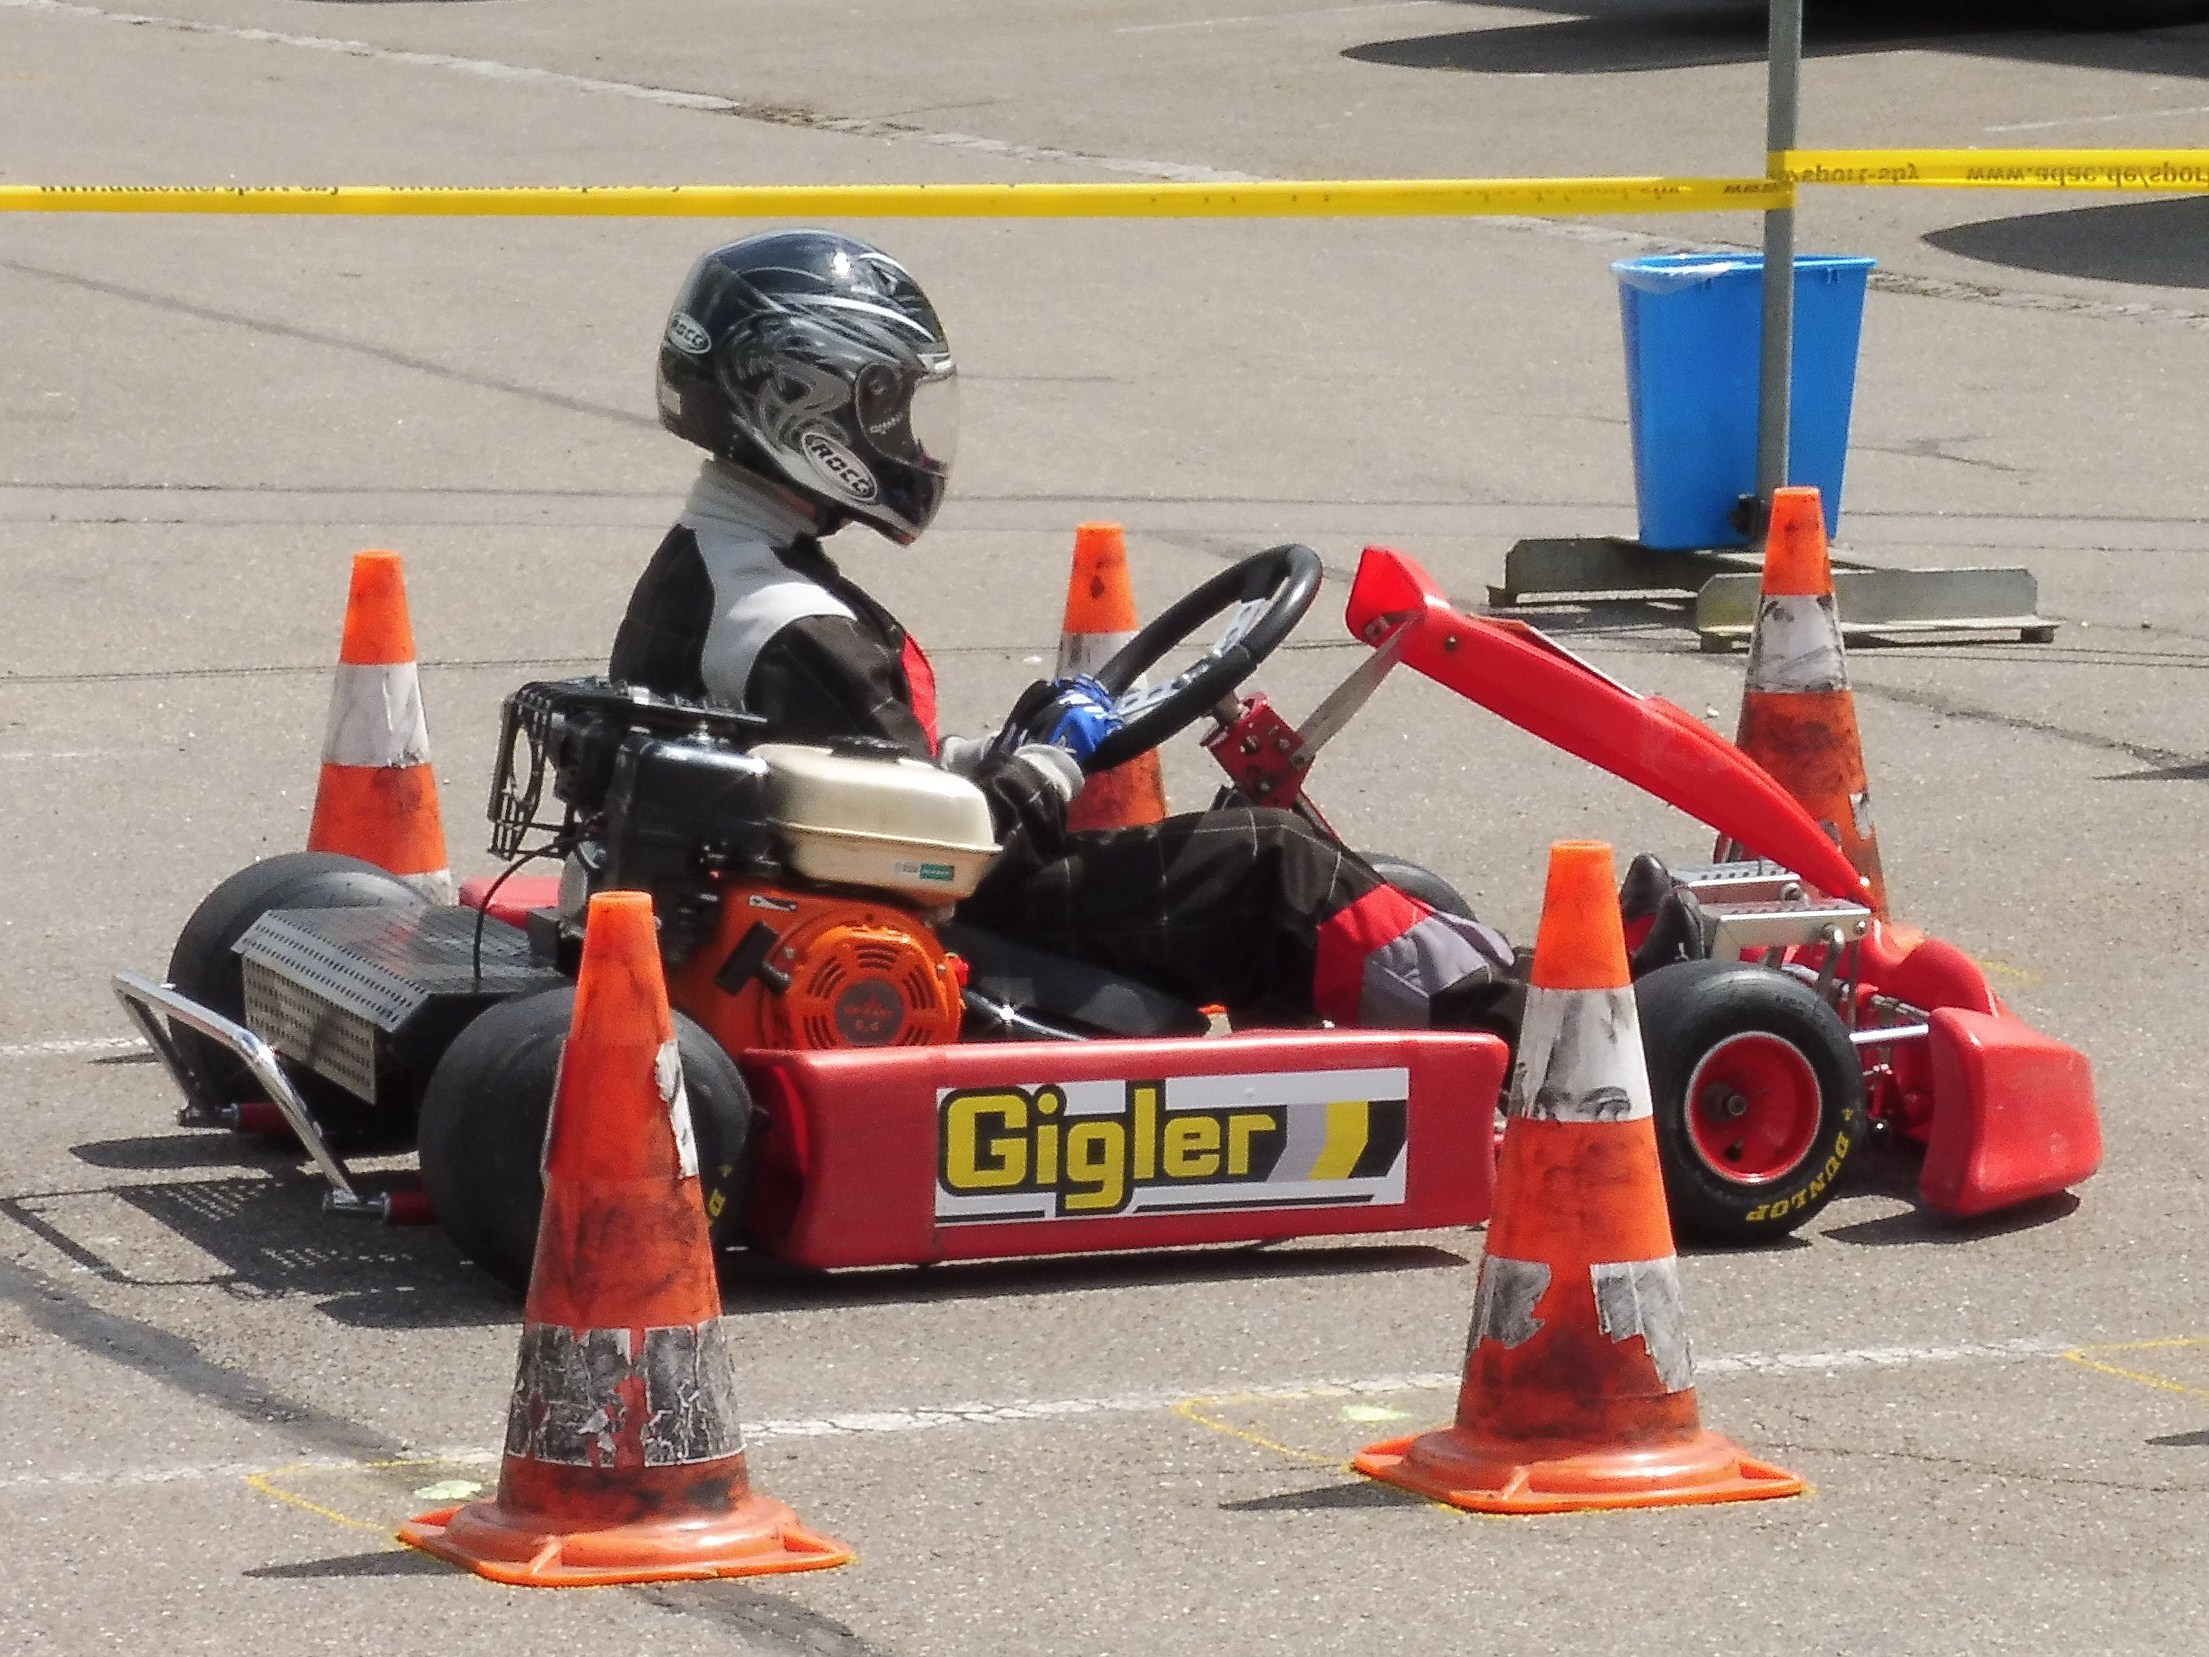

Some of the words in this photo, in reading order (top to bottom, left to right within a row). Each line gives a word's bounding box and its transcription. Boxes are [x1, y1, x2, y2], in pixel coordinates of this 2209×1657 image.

[810, 442, 873, 493] ROCC
[942, 1082, 1281, 1212] Gigler
[1744, 1130, 1849, 1222] DUNLOP
